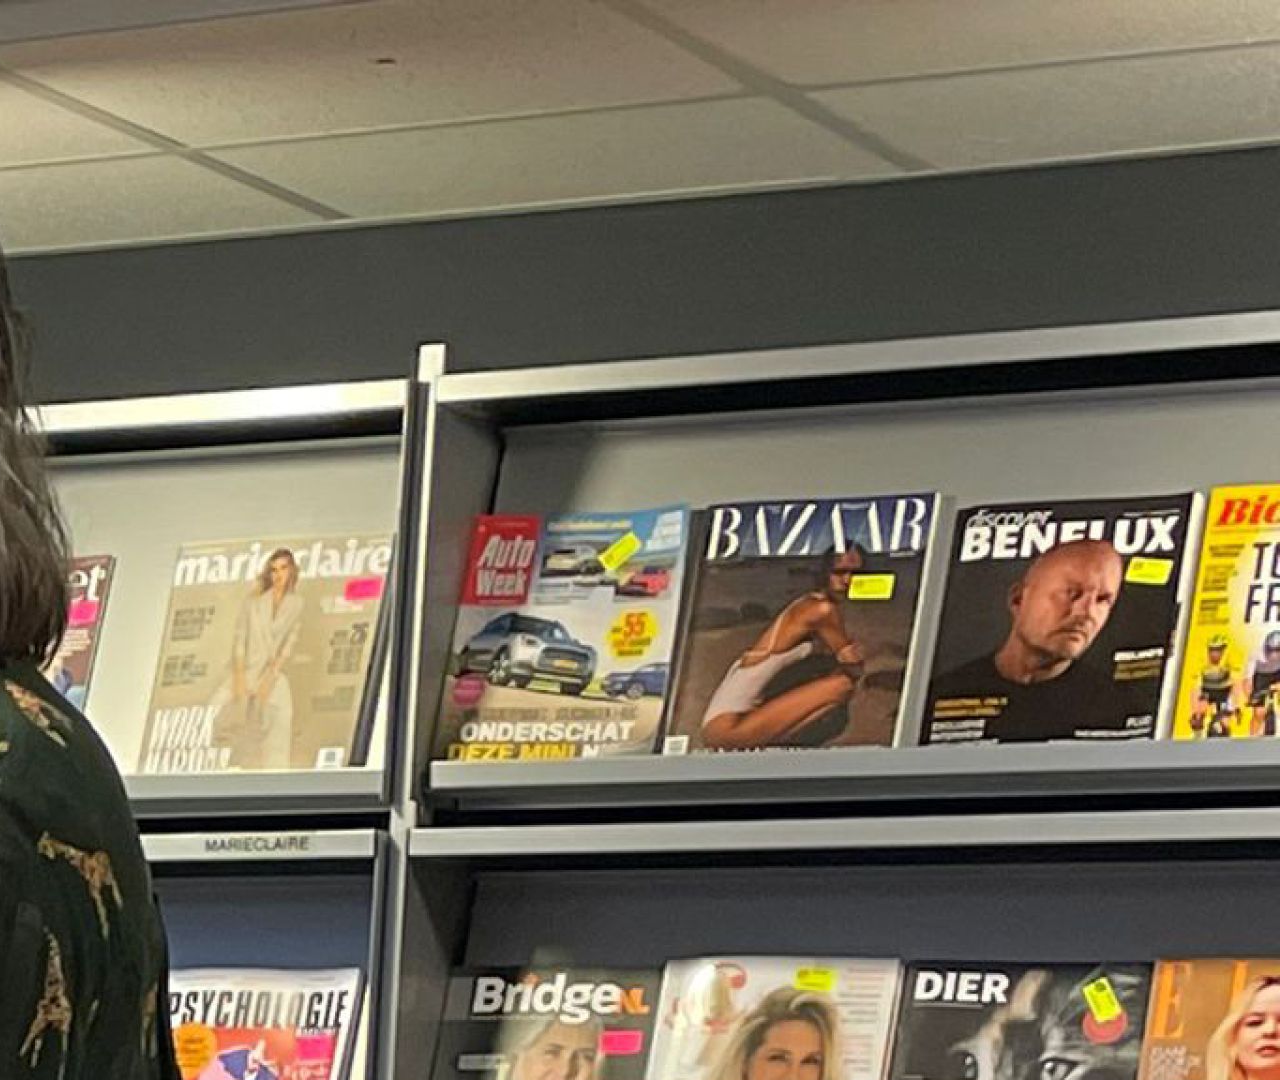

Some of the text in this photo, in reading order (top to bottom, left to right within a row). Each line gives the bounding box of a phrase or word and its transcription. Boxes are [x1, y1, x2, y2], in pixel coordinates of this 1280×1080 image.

[706, 498, 928, 561] BAZAAR
[477, 534, 537, 568] Auto
[474, 569, 528, 597] Week
[460, 721, 635, 742] ONDERSCHAT
[205, 836, 310, 852] MARIECLAIRE
[913, 970, 1011, 1004] DIER
[170, 988, 349, 1031] PSYCHOLOGIE
